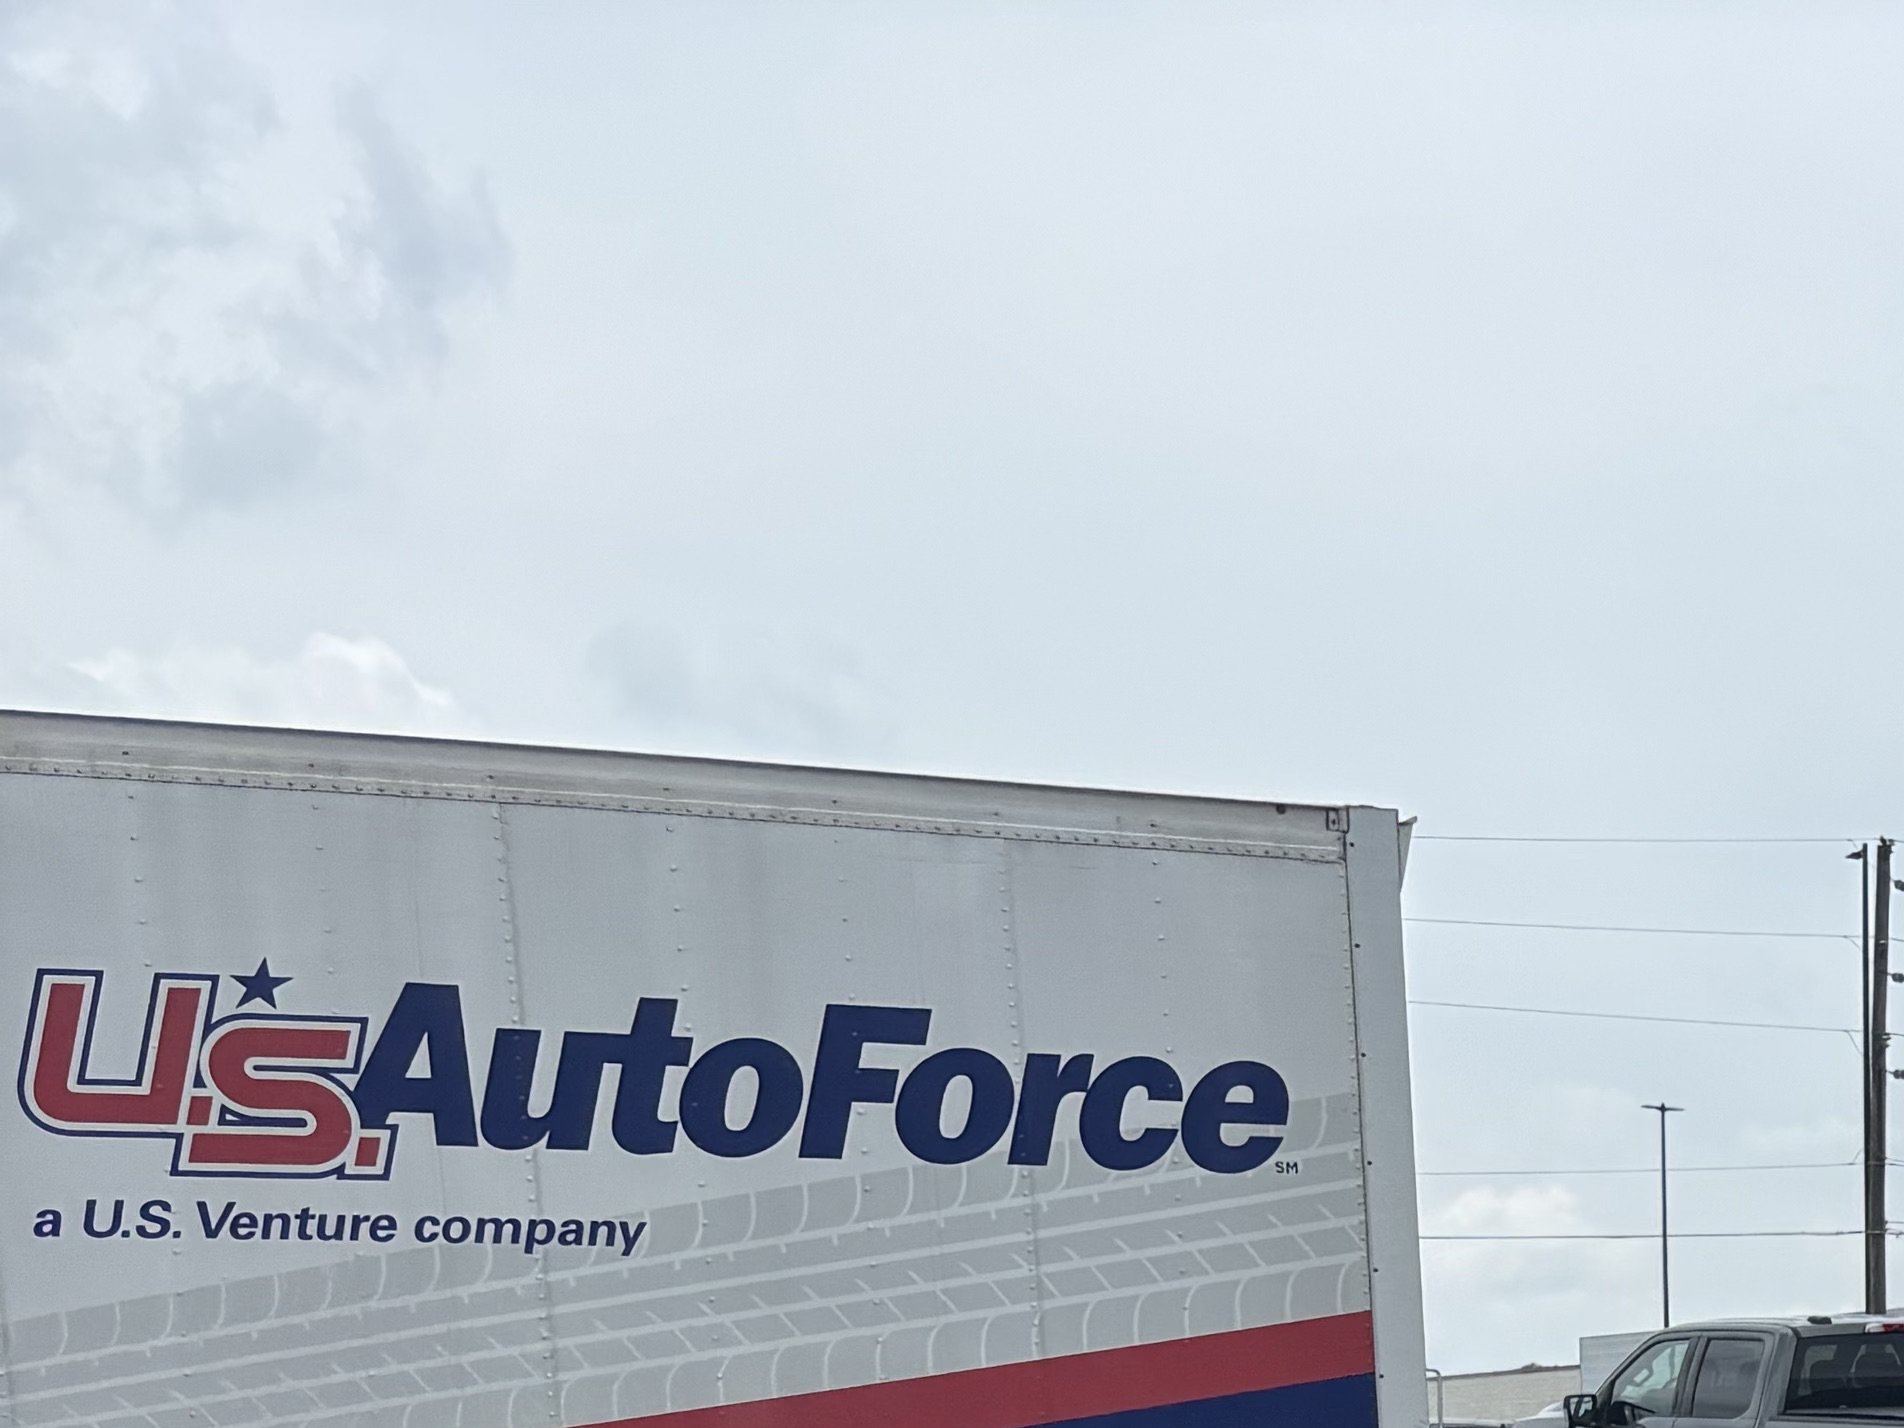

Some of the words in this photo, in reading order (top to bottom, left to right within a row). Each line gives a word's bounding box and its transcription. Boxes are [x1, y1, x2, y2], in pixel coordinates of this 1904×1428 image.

[1275, 1161, 1298, 1174] SM
[33, 1208, 62, 1238] a
[82, 1199, 182, 1239] U.S.
[196, 1201, 397, 1242] Venture
[414, 1214, 647, 1256] company
